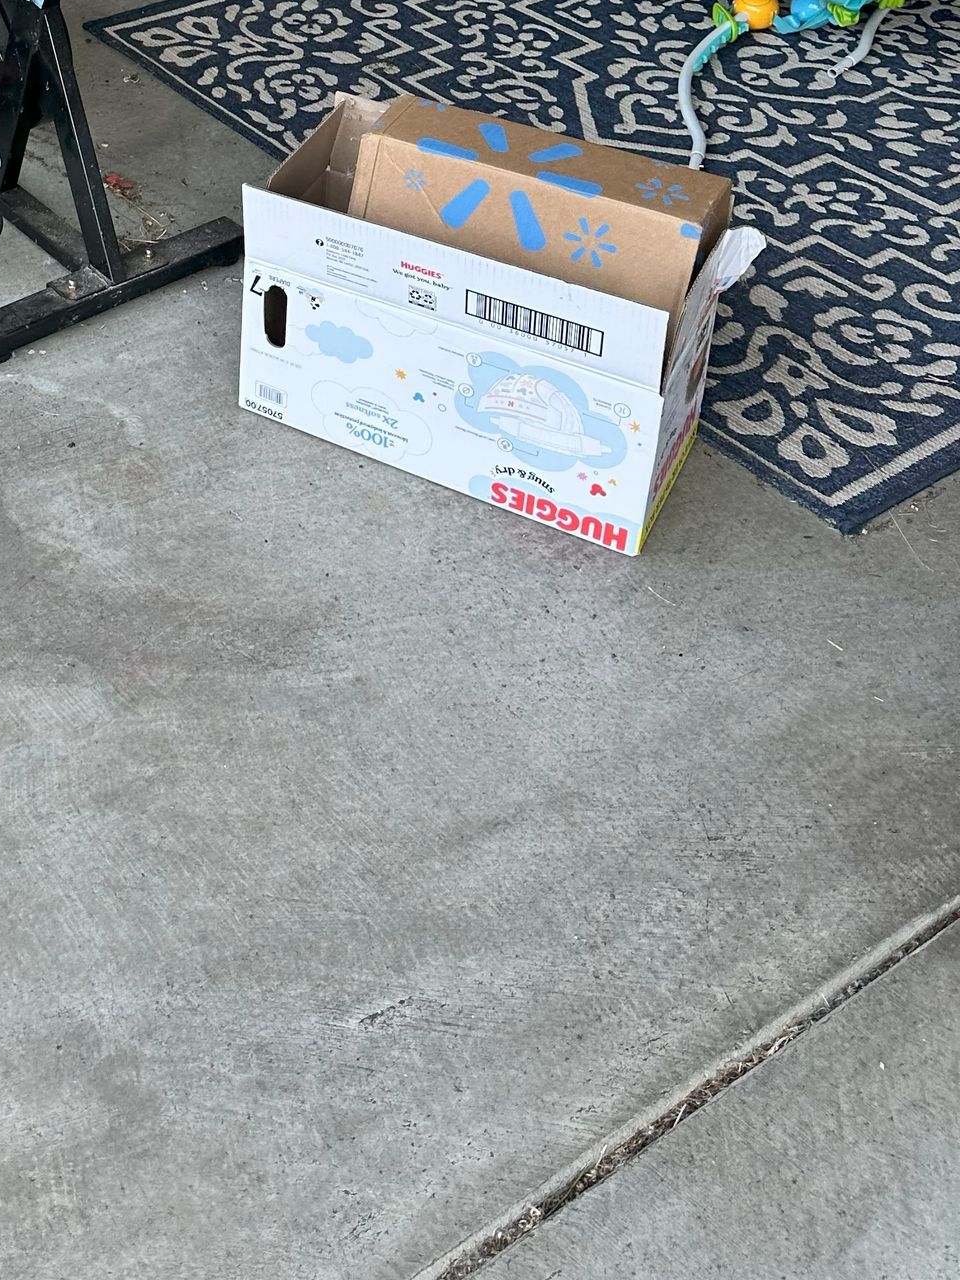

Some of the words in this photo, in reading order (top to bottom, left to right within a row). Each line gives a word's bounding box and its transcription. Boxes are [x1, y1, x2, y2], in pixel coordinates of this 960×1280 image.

[392, 268, 404, 276] We
[404, 270, 416, 280] got
[432, 280, 450, 291] baby
[401, 260, 442, 280] HUGGIES
[250, 275, 262, 296] 7
[495, 465, 516, 476] dry
[517, 467, 527, 478] &
[527, 471, 556, 494] snug
[491, 482, 628, 551] HUGGIES
